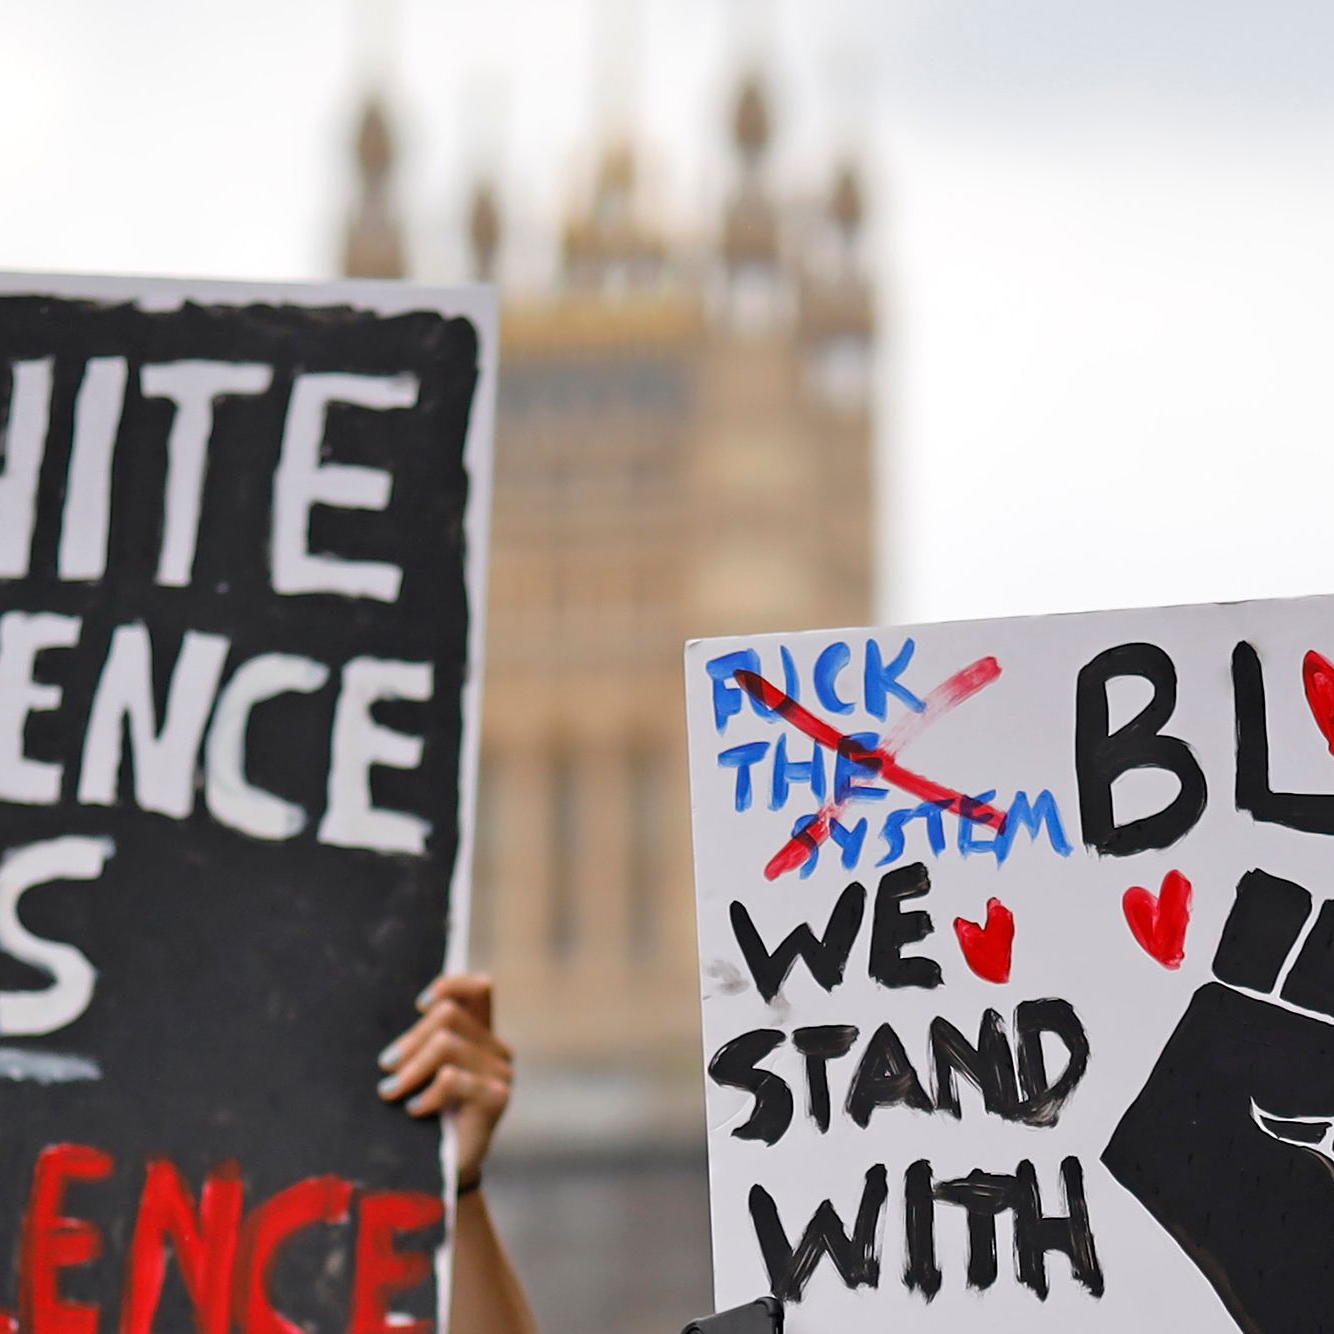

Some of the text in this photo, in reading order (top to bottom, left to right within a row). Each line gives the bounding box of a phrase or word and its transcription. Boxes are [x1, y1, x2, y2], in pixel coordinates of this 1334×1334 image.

[705, 638, 926, 735] FUCK
[717, 731, 890, 812] THE
[789, 789, 1073, 879] SYSTEM
[730, 862, 944, 1004] WE
[707, 998, 1091, 1146] STAND
[748, 1155, 1104, 1302] WITH
